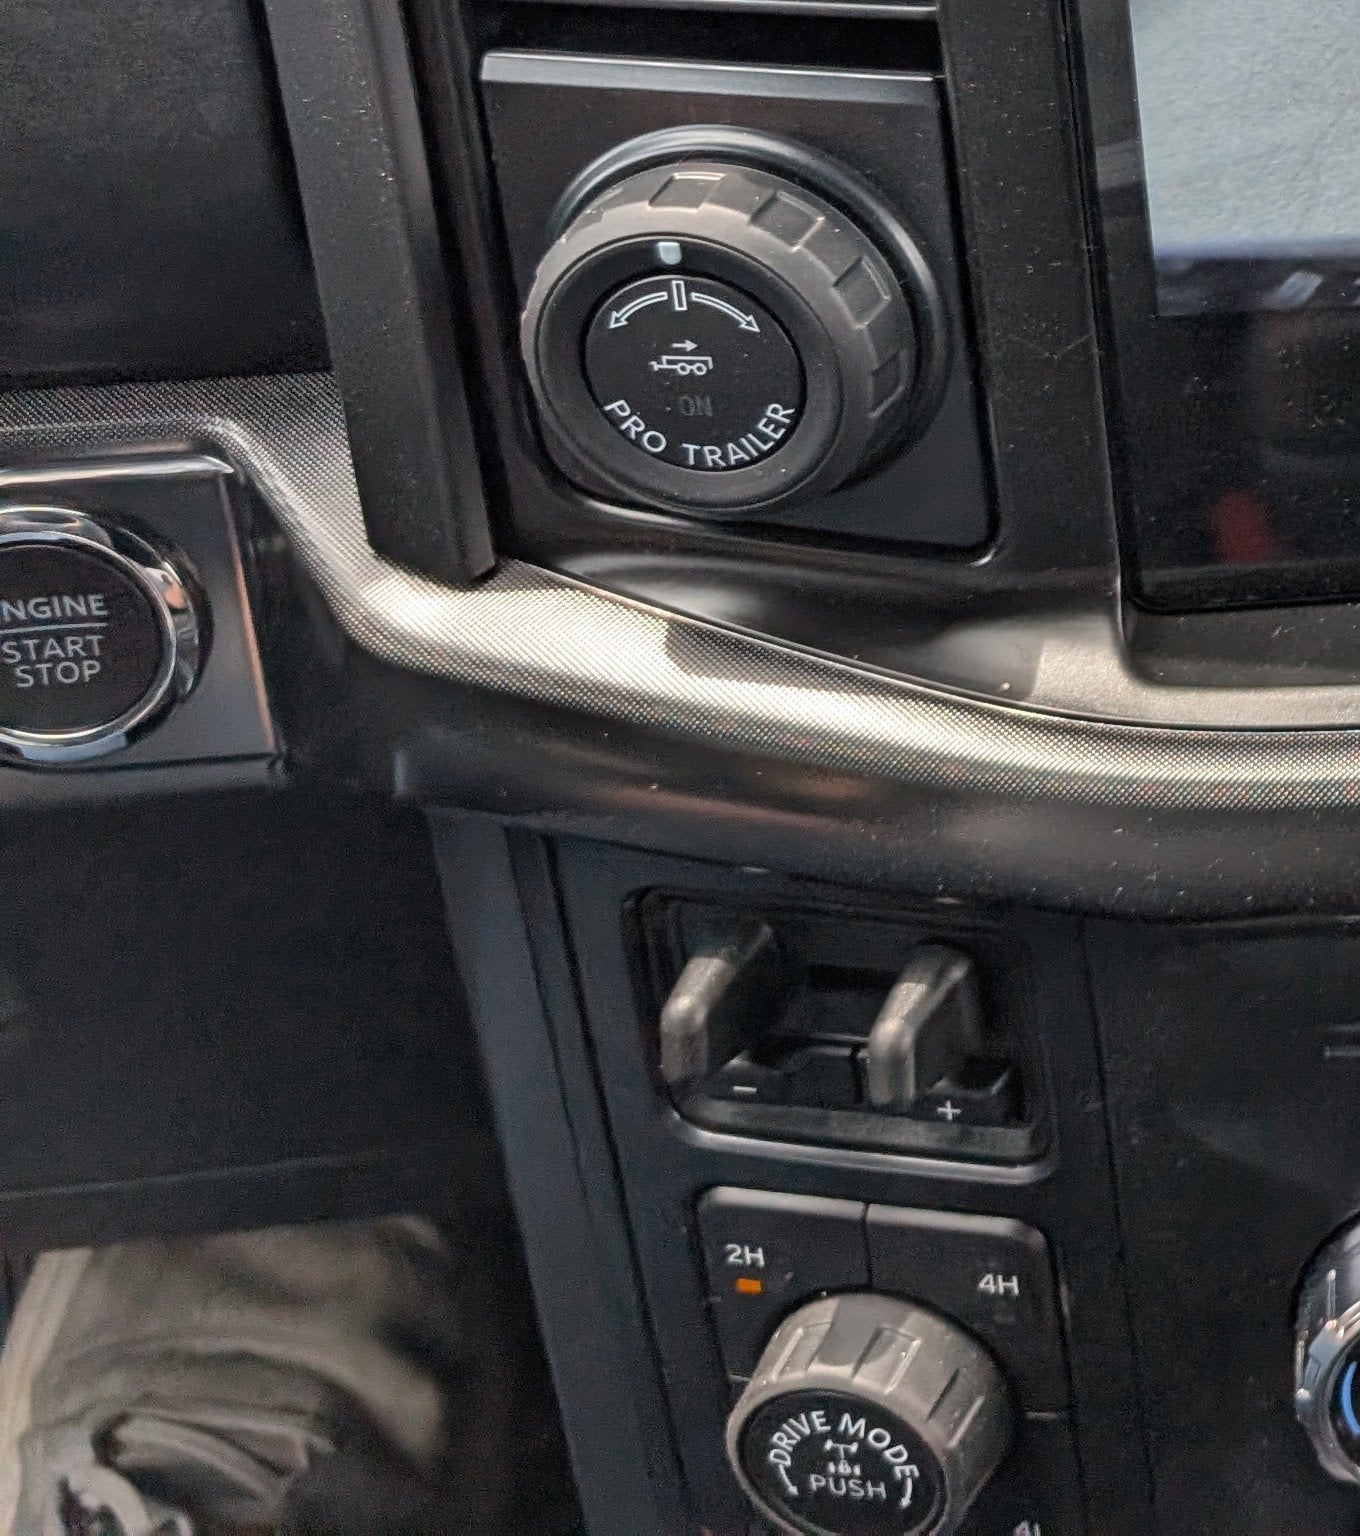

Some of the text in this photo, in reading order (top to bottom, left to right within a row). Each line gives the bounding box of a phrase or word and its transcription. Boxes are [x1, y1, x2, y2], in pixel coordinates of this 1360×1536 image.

[603, 398, 796, 468] PRO TRAILER
[0, 594, 109, 622] NGINE
[1, 635, 104, 664] START
[15, 660, 101, 688] STOP
[724, 1244, 765, 1267] 2H
[977, 1273, 1020, 1297] 4H
[768, 1410, 920, 1480] DRIVE MODE
[809, 1474, 887, 1500] PUSH
